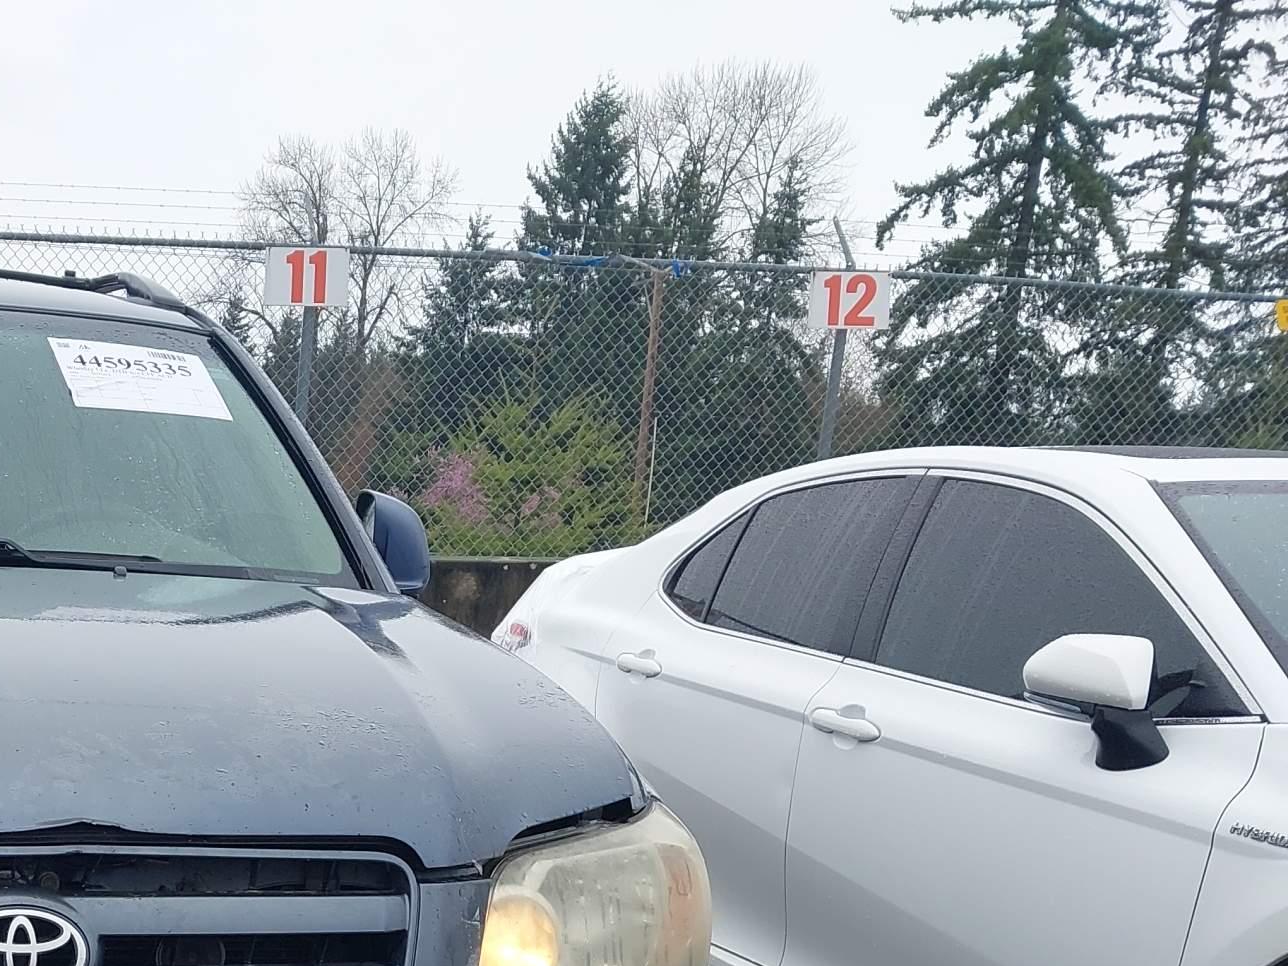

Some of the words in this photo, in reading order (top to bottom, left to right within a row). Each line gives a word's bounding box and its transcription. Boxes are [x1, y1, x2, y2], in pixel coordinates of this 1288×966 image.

[286, 250, 327, 303] 11
[824, 274, 877, 326] 12
[73, 354, 192, 377] 44595335
